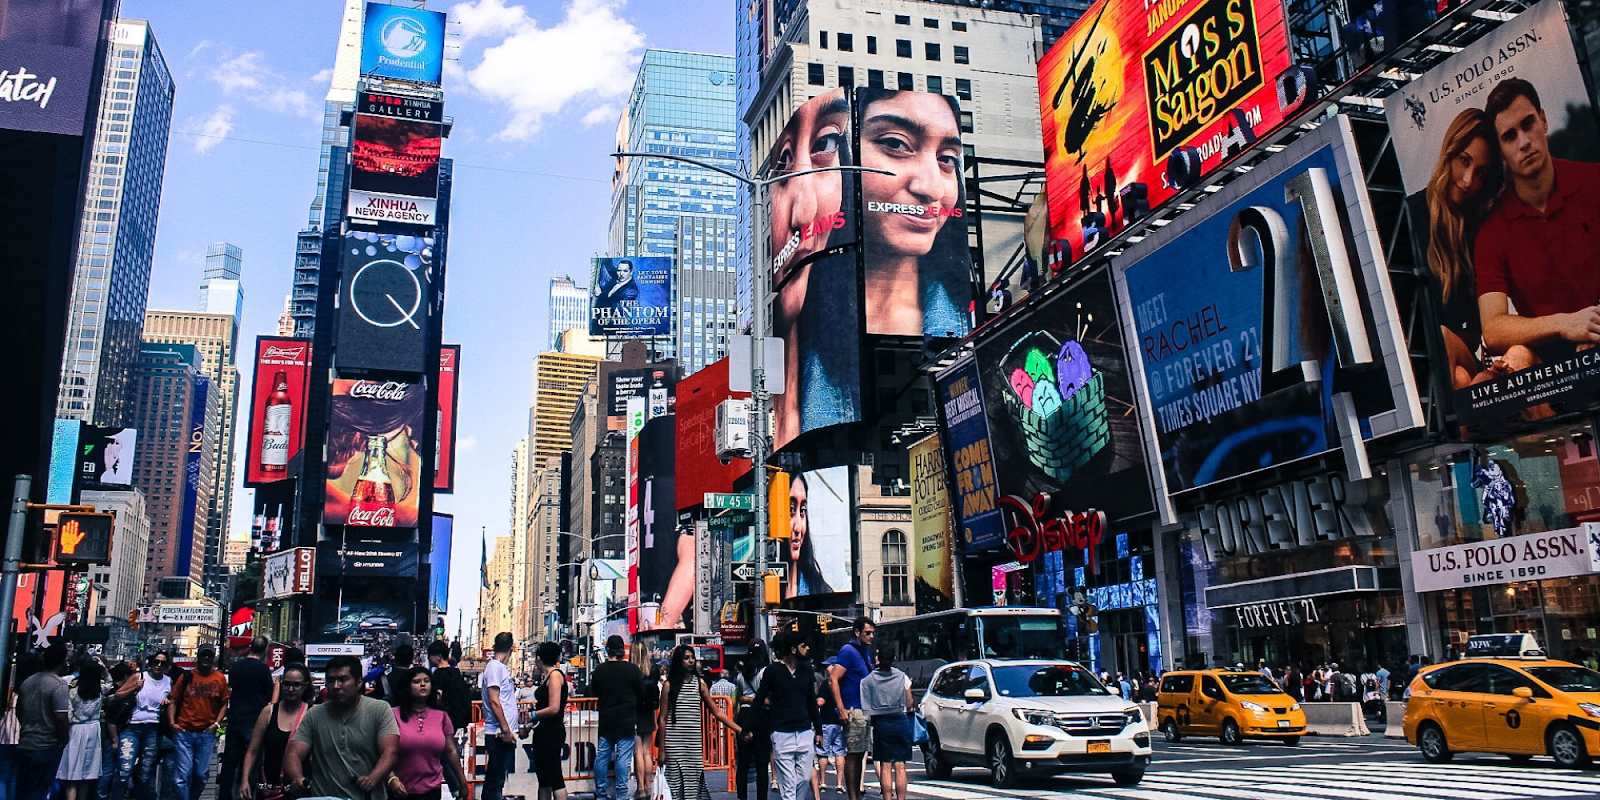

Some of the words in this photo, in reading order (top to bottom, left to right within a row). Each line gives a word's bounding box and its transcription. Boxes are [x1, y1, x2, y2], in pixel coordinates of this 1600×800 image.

[378, 55, 425, 70] Prudential
[1428, 81, 1454, 104] U.S.
[1455, 55, 1494, 89] POLO
[1499, 28, 1543, 64] ASSN.
[1155, 41, 1255, 143] Saigon
[1454, 82, 1485, 105] SINCE
[1489, 65, 1515, 85] 1890
[369, 104, 431, 119] GALLERY
[403, 100, 431, 109] XINHUA
[355, 207, 385, 218] NEWS
[387, 211, 429, 222] AGENCY
[367, 197, 418, 213] XINHUA
[867, 201, 925, 216] EXPRESS
[925, 206, 963, 218] JEANS
[773, 230, 801, 275] EXPRESS
[799, 211, 846, 243] JEANS
[350, 259, 420, 330] Q
[1227, 167, 1373, 399] 21
[591, 306, 669, 319] PHANTOM
[598, 318, 610, 326] OF
[612, 318, 630, 326] THE
[631, 317, 662, 325] OPERA
[1137, 292, 1168, 333] MEET
[1144, 303, 1227, 364] RACHEL
[1151, 371, 1163, 399] @
[1164, 339, 1236, 393] FOREVER
[1240, 326, 1261, 361] 21
[1471, 384, 1500, 400] LIVE
[1507, 352, 1600, 389] AUTHENTICA
[350, 379, 408, 401] Coca-Cola
[1472, 399, 1494, 409] PAMELA
[1495, 389, 1526, 404] FLANAGAN
[1533, 381, 1555, 393] JONNY
[1556, 374, 1580, 386] LAVINE
[1586, 367, 1600, 377] POL
[1526, 384, 1573, 403] USPOLOASSN.COM
[944, 399, 958, 419] BEST
[1158, 396, 1193, 433] TIMES
[1192, 377, 1241, 424] SQUARE
[954, 438, 990, 472] COME
[716, 495, 725, 507] W
[729, 495, 741, 508] 45
[962, 486, 996, 518] AWAY
[347, 504, 396, 527] Coca-Cola
[709, 517, 731, 527] George
[874, 512, 887, 520] THE
[1195, 471, 1372, 562] FOREVER
[922, 531, 944, 545] BROADWAY
[922, 543, 936, 553] SPRING
[1427, 551, 1461, 573] U.S.
[1463, 543, 1517, 569] POLO
[1523, 534, 1585, 562] ASSN.
[299, 549, 311, 591] HELLO!
[1463, 570, 1504, 583] SINCE
[1510, 565, 1546, 578] 1890
[162, 606, 189, 614] PEDESTRIAN
[1236, 601, 1301, 629] FOREVER
[1301, 598, 1320, 623] 21
